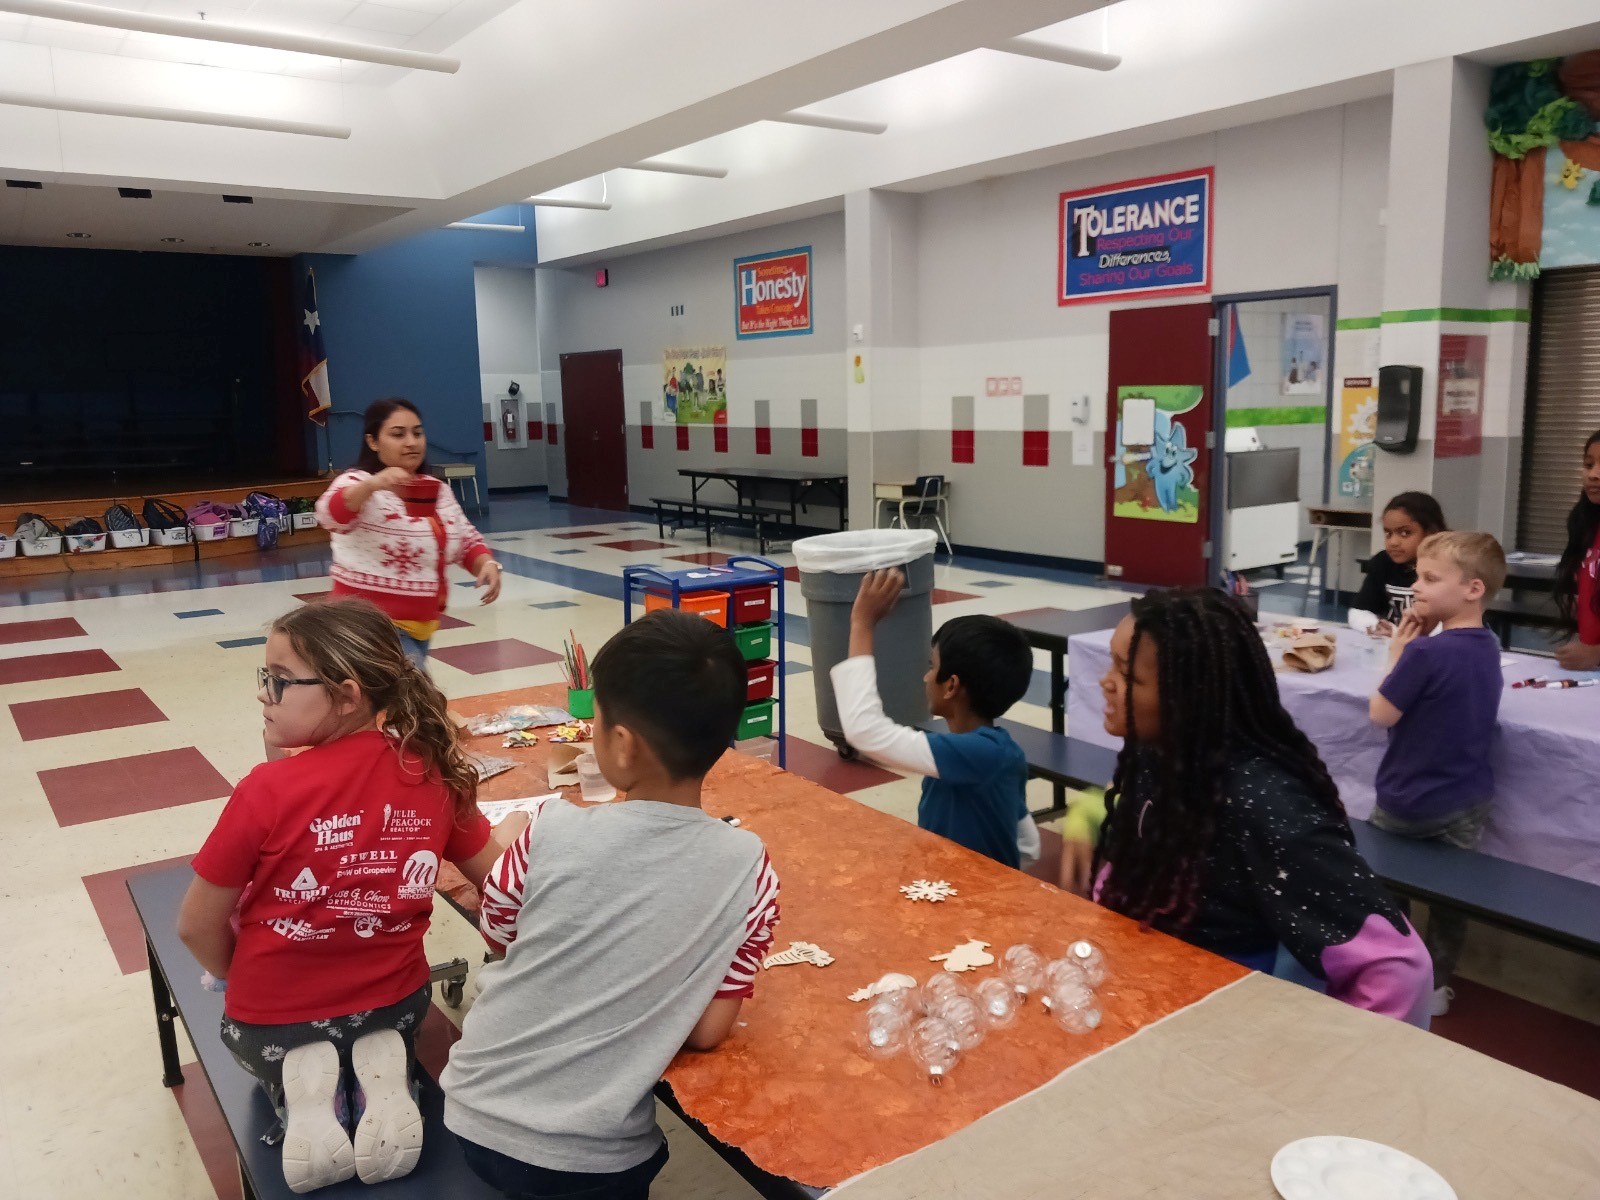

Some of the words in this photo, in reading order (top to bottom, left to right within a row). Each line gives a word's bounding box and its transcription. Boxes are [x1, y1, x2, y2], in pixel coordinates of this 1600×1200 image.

[1073, 194, 1200, 257] TOLERANCE
[1096, 232, 1165, 251] Respecting
[1168, 228, 1194, 241] Our
[1079, 270, 1125, 286] Sharing
[1128, 267, 1153, 281] Our
[1156, 263, 1194, 277] Goals
[741, 269, 807, 308] Honesty
[390, 818, 432, 826] PEACOCK
[393, 809, 416, 818] JULIE
[309, 813, 361, 833] Golden
[316, 830, 354, 845] Haus
[354, 867, 361, 875] of
[327, 899, 391, 910] ORTHODONTICS
